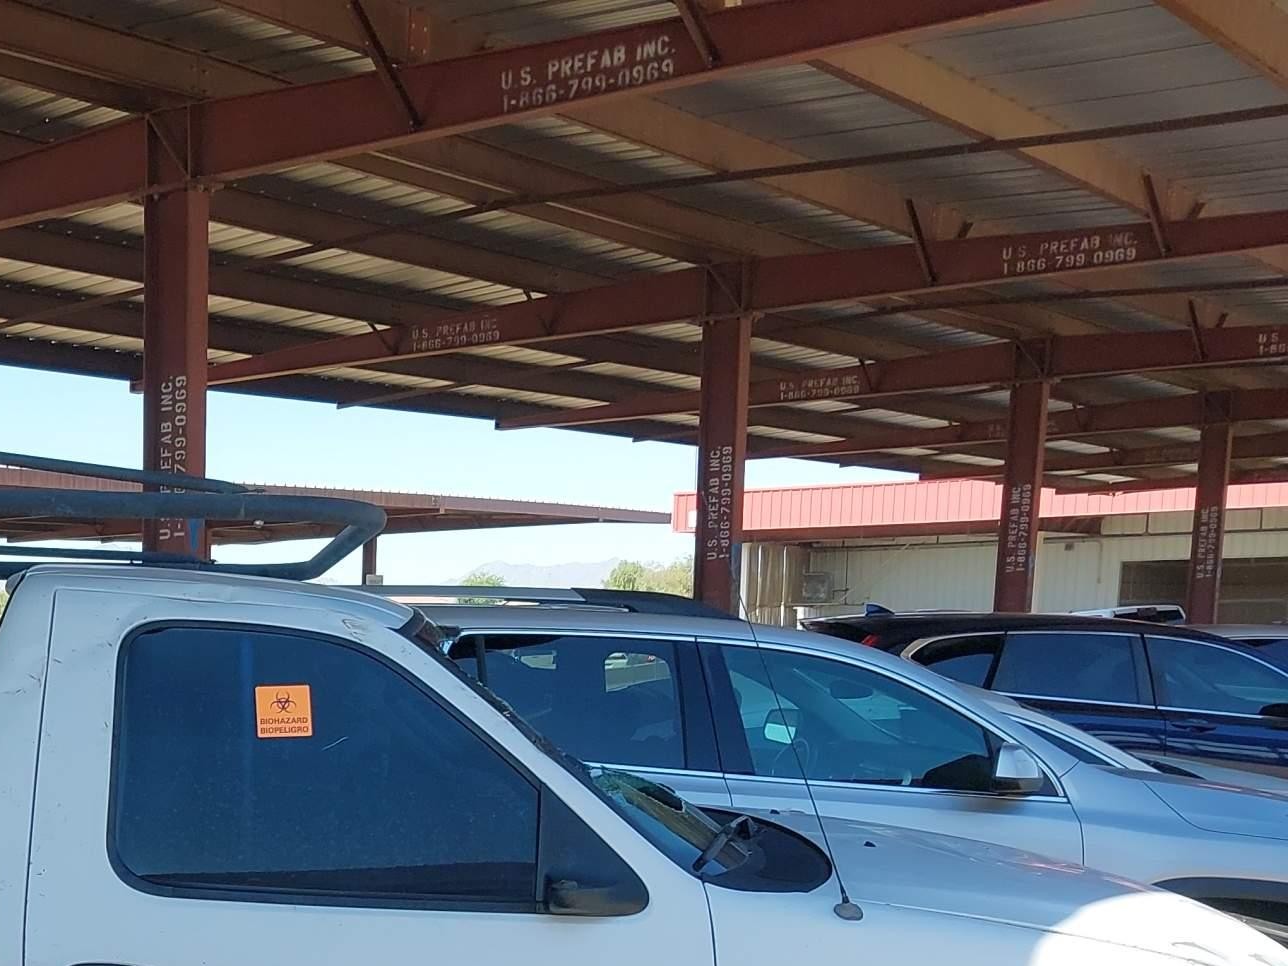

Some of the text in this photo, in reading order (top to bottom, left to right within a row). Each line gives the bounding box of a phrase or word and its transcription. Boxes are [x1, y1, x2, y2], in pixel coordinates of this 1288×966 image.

[547, 45, 626, 81] PREFAB
[635, 34, 677, 61] INC.
[503, 58, 675, 113] 1-866-799-0969
[1039, 235, 1101, 255] PREFAB
[160, 375, 174, 412] INC.
[159, 421, 173, 494] PEFAB
[709, 445, 721, 471] INC.
[708, 477, 720, 529] PREFAB
[718, 446, 733, 558] 1-866-799-0969
[1007, 508, 1020, 548] PREFAB
[259, 716, 309, 725] BIOHAZARD
[260, 726, 309, 734] BIOPELIGRO
